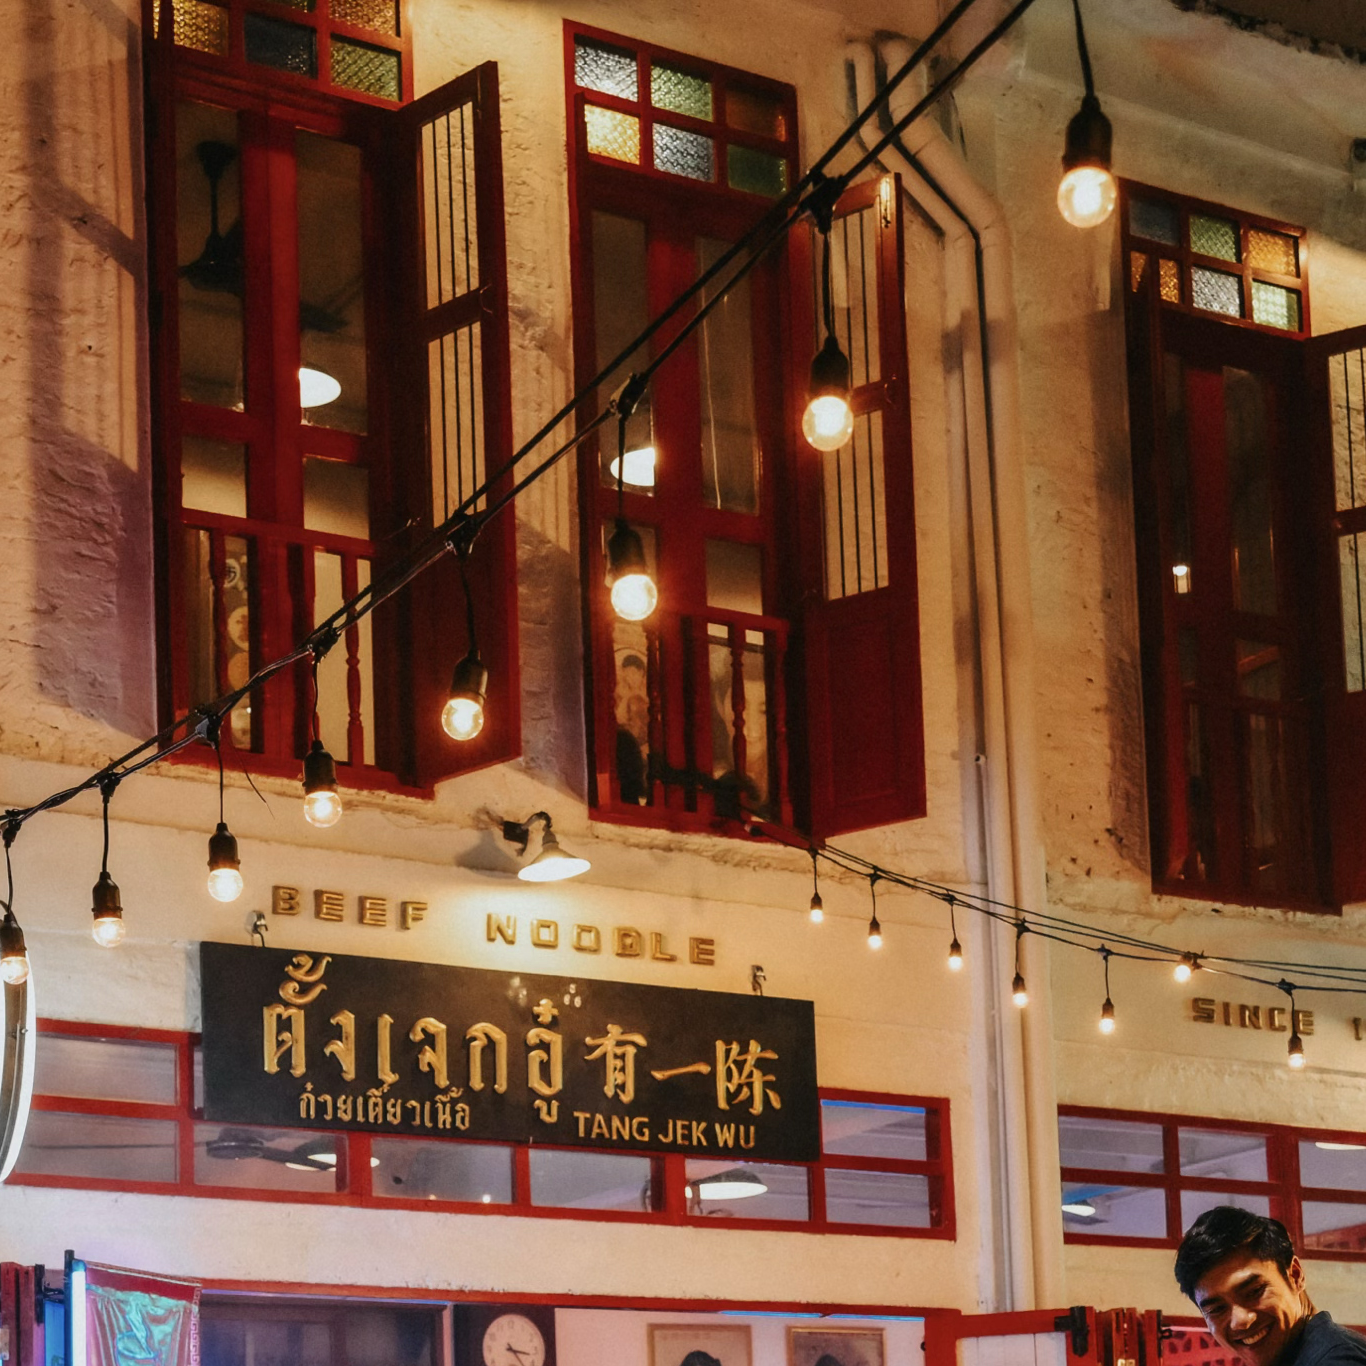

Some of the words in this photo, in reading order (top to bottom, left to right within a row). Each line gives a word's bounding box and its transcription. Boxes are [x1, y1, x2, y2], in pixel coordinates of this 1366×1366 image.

[271, 883, 431, 932] BEEF
[486, 910, 718, 968] NOODLE
[262, 952, 563, 1124] ตั้งเจกอู๋
[1191, 996, 1316, 1037] SINCE
[573, 1111, 651, 1143] TANG
[658, 1119, 708, 1147] JEK
[715, 1122, 756, 1150] WU
